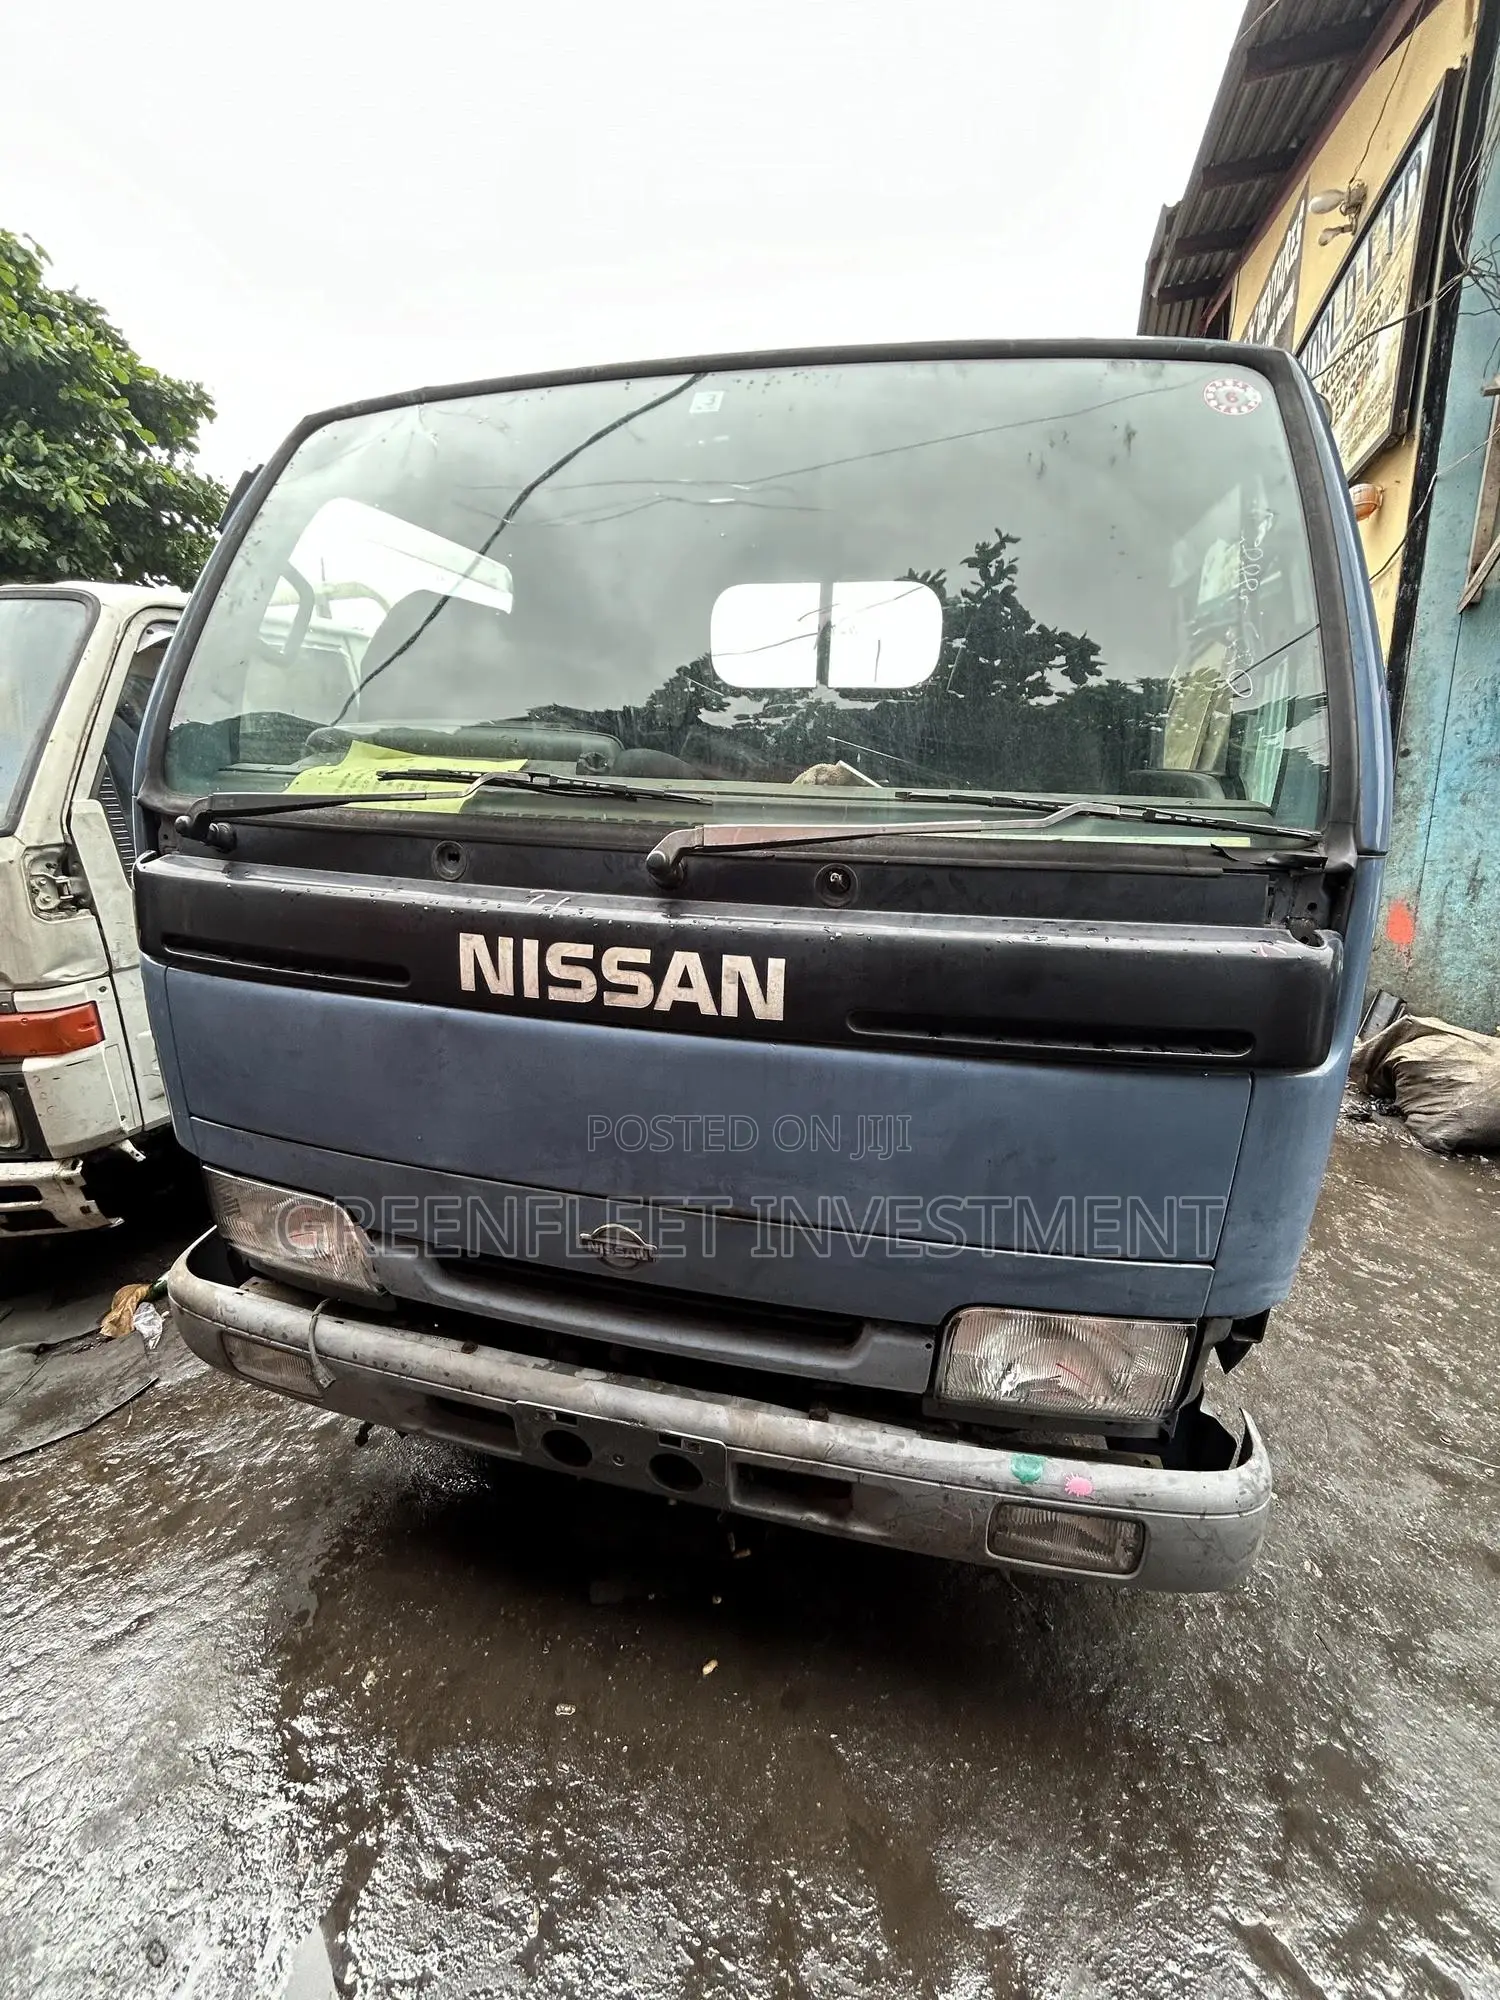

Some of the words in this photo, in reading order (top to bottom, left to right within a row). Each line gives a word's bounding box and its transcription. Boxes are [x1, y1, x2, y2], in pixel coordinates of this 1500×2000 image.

[1367, 150, 1422, 295] LTD
[459, 932, 786, 1021] NISSAN
[590, 1241, 649, 1260] NISSAN
